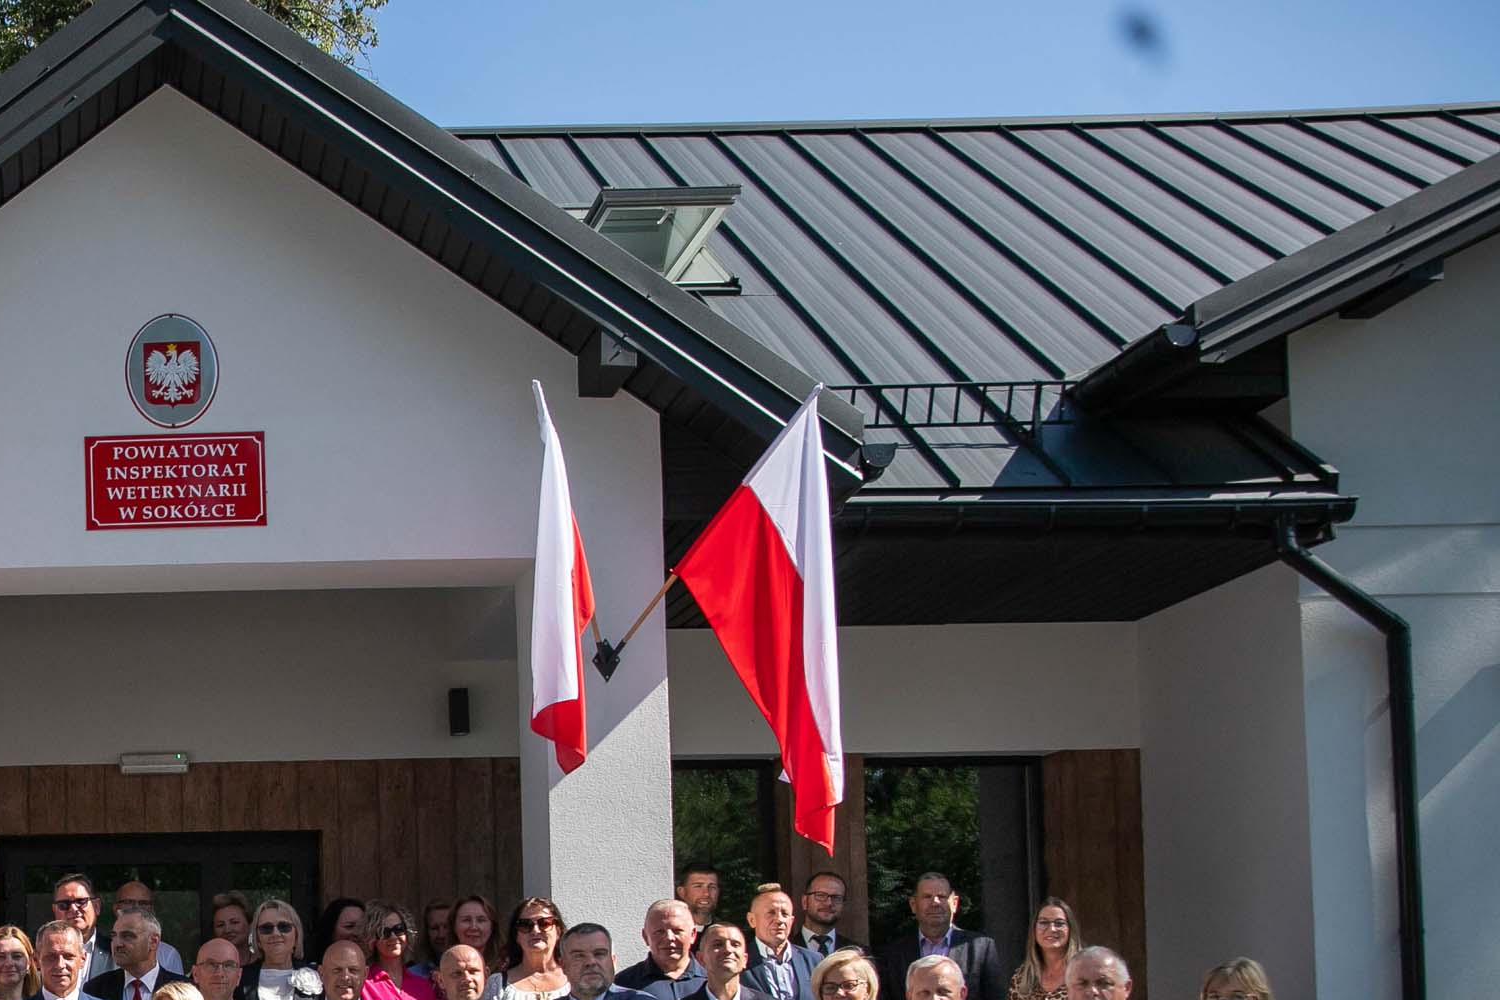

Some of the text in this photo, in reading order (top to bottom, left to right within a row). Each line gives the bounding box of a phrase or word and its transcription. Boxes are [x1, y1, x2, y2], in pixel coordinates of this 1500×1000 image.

[113, 443, 239, 460] POWIATOWY
[106, 463, 247, 480] INSPEKTORAT
[106, 483, 247, 500] WETERYNARII
[119, 502, 236, 520] W SOKÓŁCE
